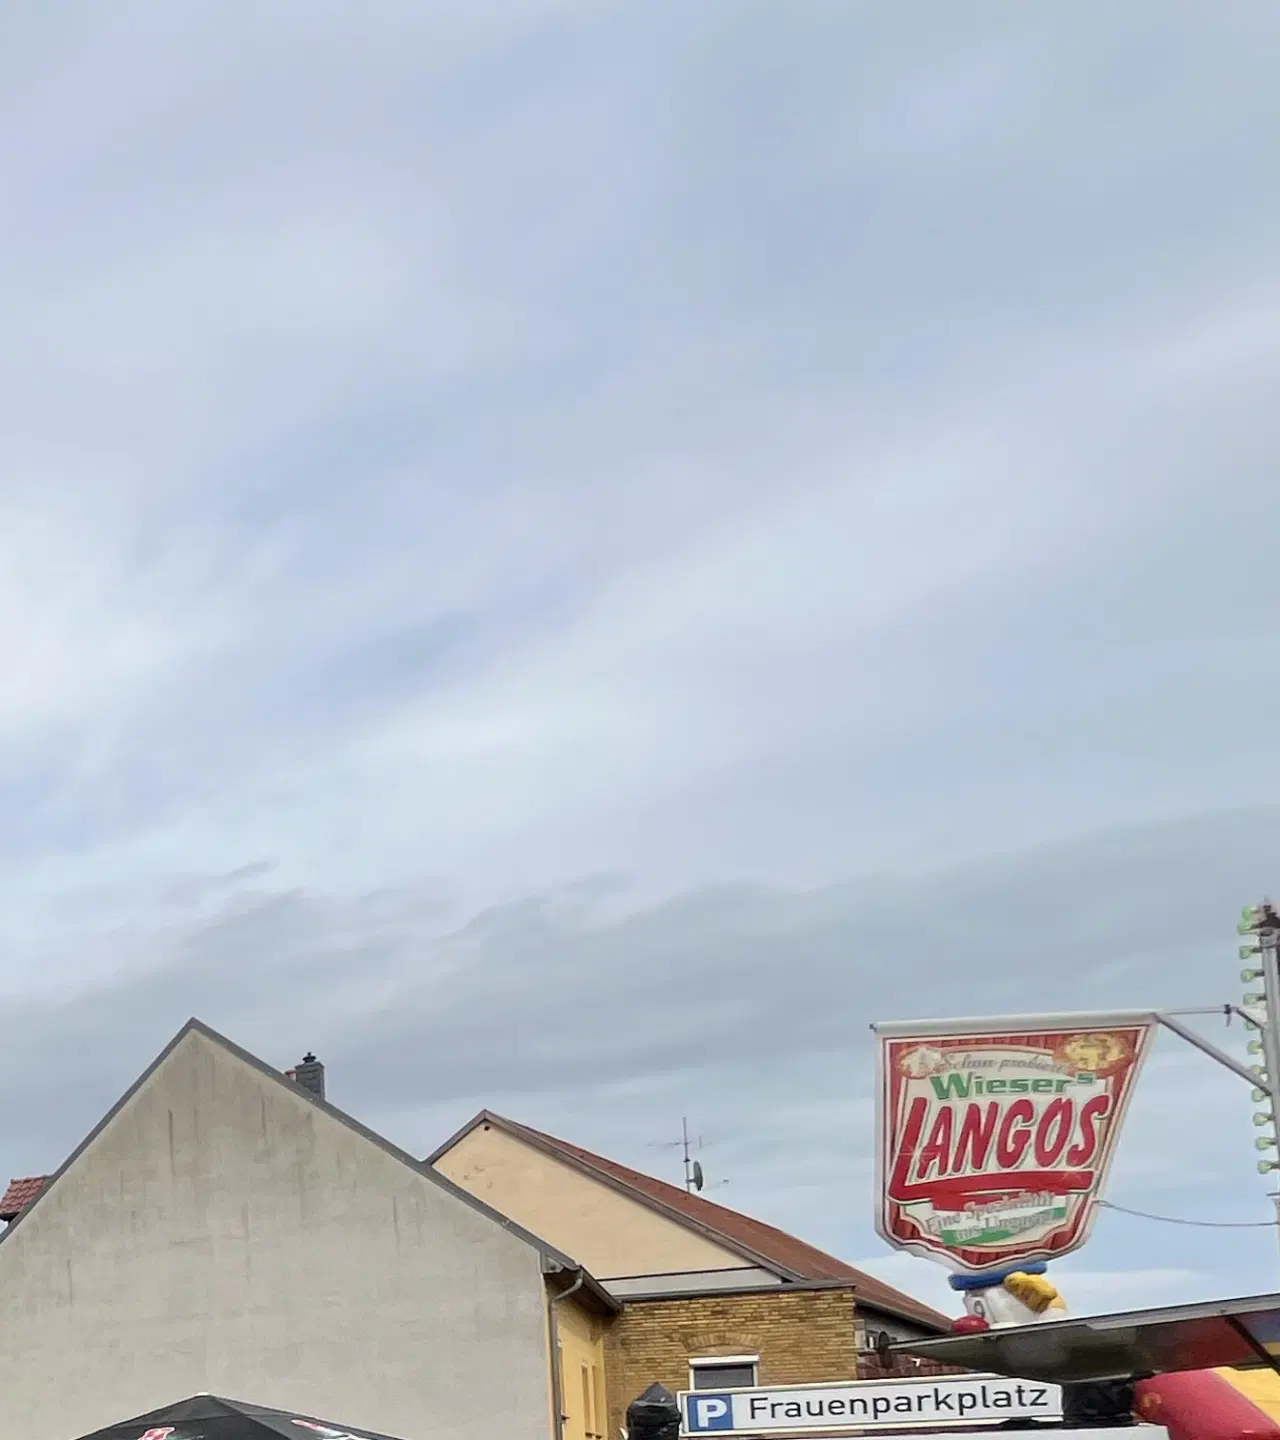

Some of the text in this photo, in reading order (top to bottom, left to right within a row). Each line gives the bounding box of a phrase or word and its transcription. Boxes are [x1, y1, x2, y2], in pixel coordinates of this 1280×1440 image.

[888, 1095, 1110, 1200] LANGOS
[697, 1385, 1050, 1428] P Frauenparkplatz
